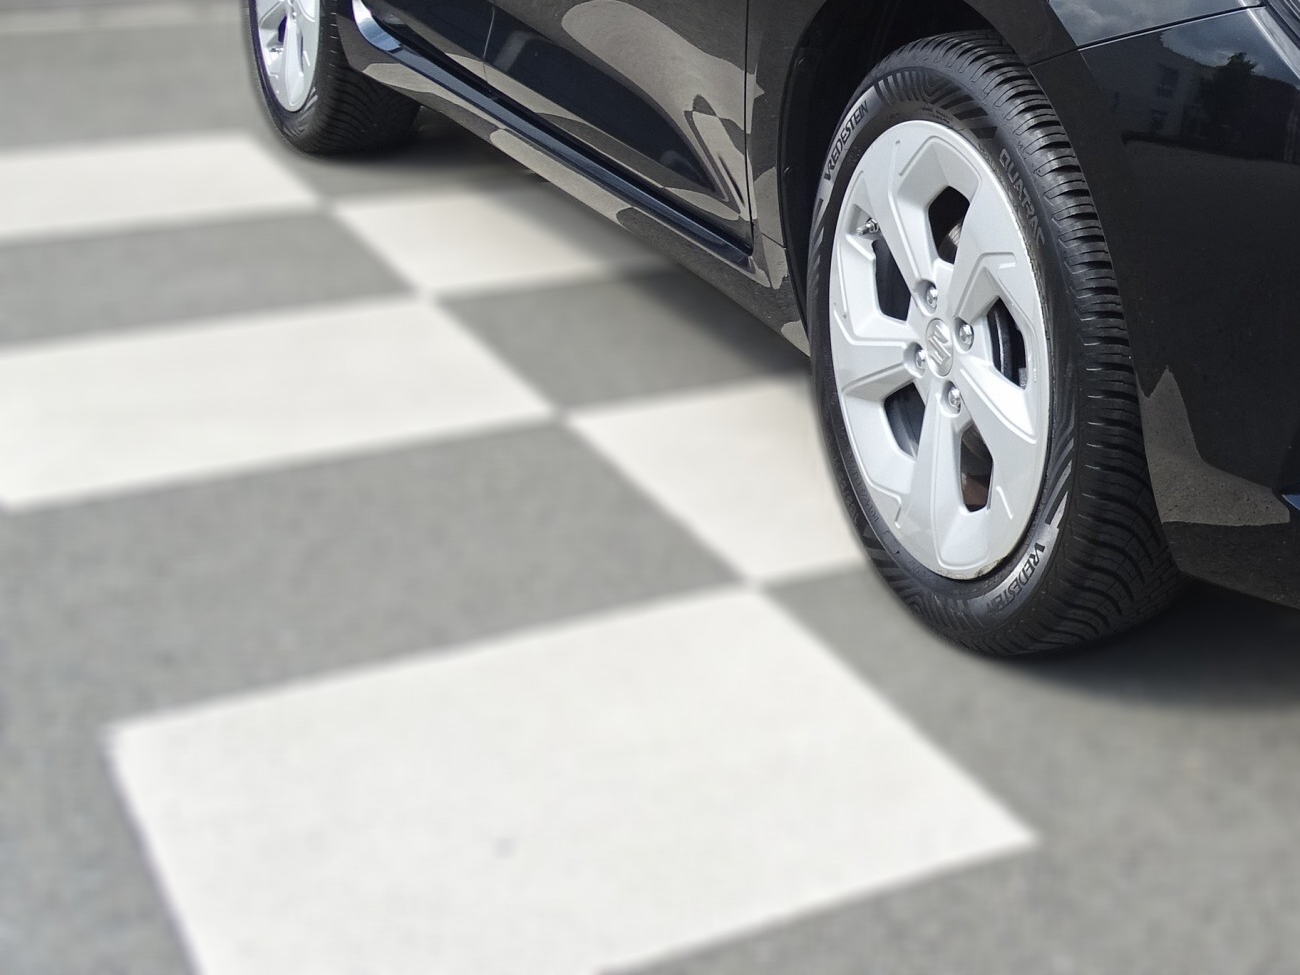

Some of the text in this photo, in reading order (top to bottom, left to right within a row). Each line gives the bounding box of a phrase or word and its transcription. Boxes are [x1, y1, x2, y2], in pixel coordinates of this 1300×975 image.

[824, 100, 869, 181] VREDESTEIN
[999, 148, 1045, 247] QUATRAC
[986, 542, 1046, 617] VREDESTEIN
